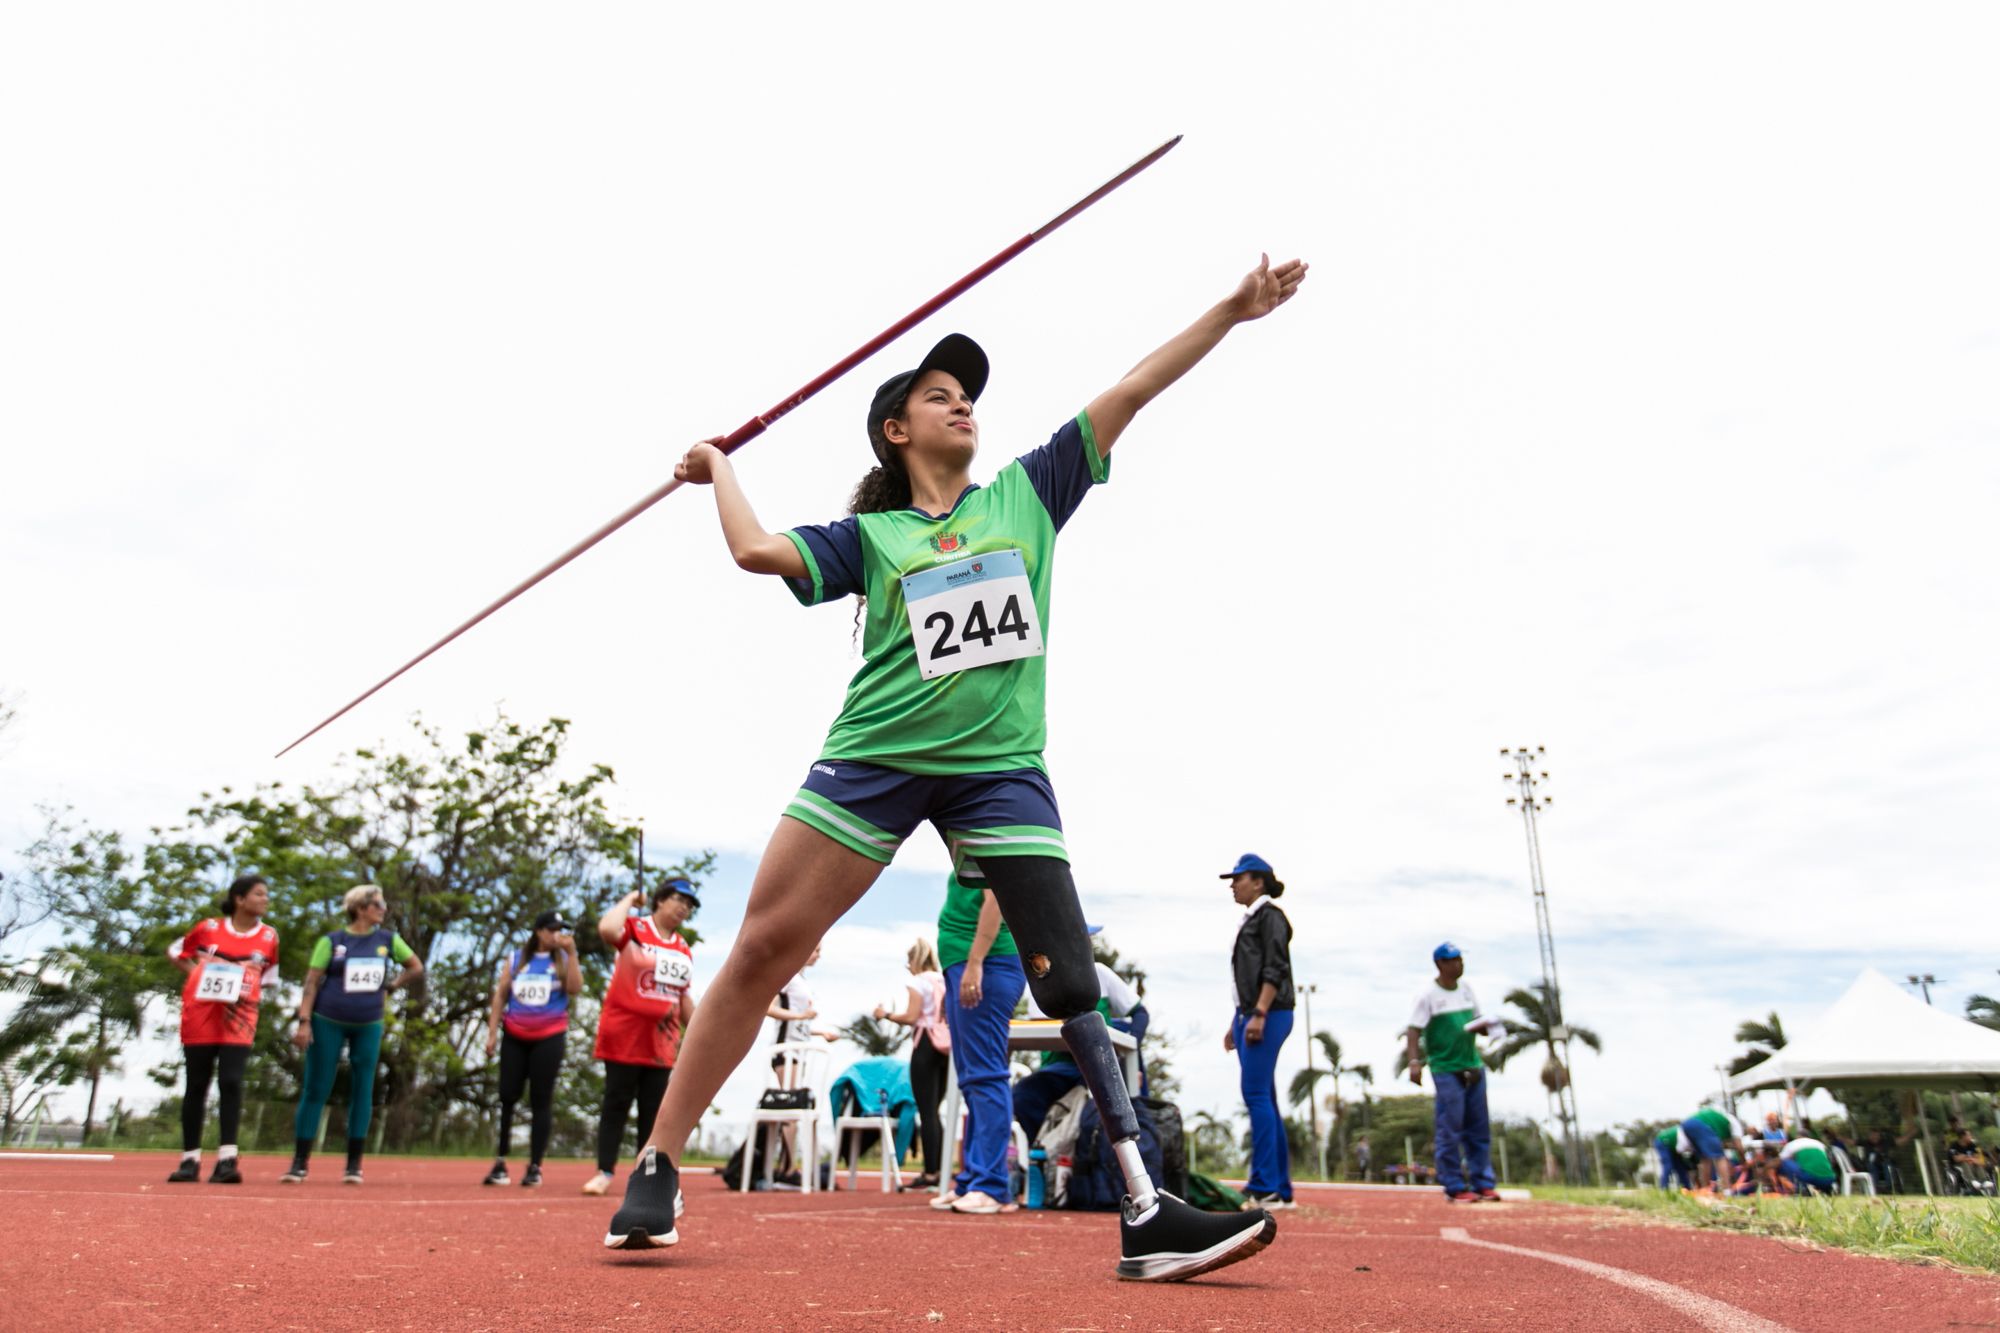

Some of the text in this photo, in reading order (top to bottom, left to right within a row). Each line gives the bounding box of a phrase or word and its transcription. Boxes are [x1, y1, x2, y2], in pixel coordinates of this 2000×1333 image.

[934, 550, 971, 563] CURITIBA
[946, 569, 971, 581] PARANÁ
[924, 594, 1030, 661] 244
[660, 960, 689, 981] 352
[351, 971, 381, 984] 449
[202, 976, 235, 994] 351
[518, 986, 546, 999] 403
